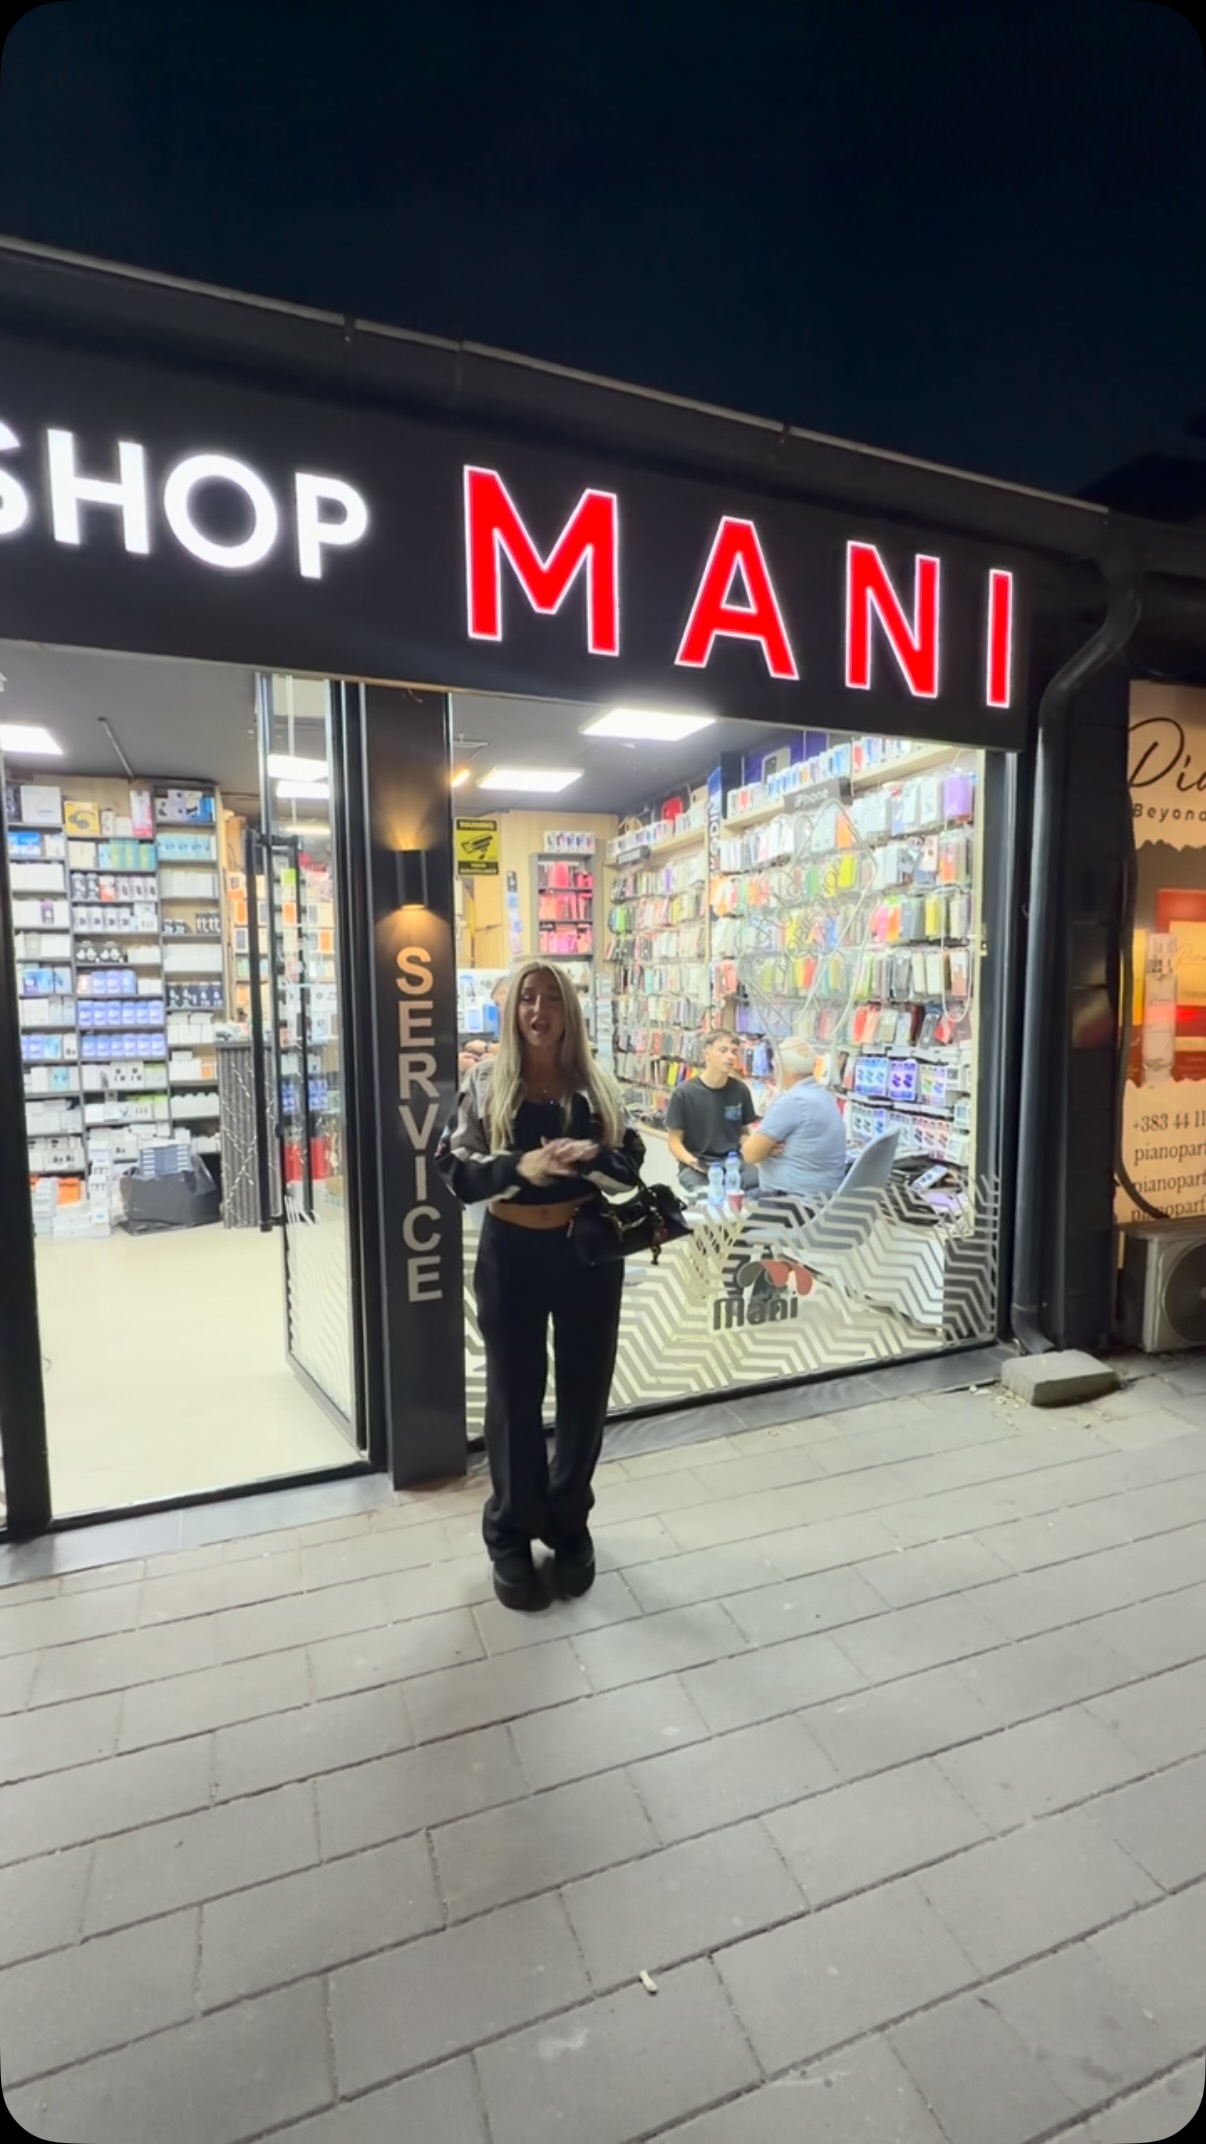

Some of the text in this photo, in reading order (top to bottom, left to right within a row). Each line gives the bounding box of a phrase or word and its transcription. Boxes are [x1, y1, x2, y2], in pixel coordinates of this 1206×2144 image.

[463, 465, 1012, 708] MANI
[396, 947, 443, 1302] SERVICE
[1133, 1113, 1168, 1132] +383
[1173, 1112, 1190, 1129] 44
